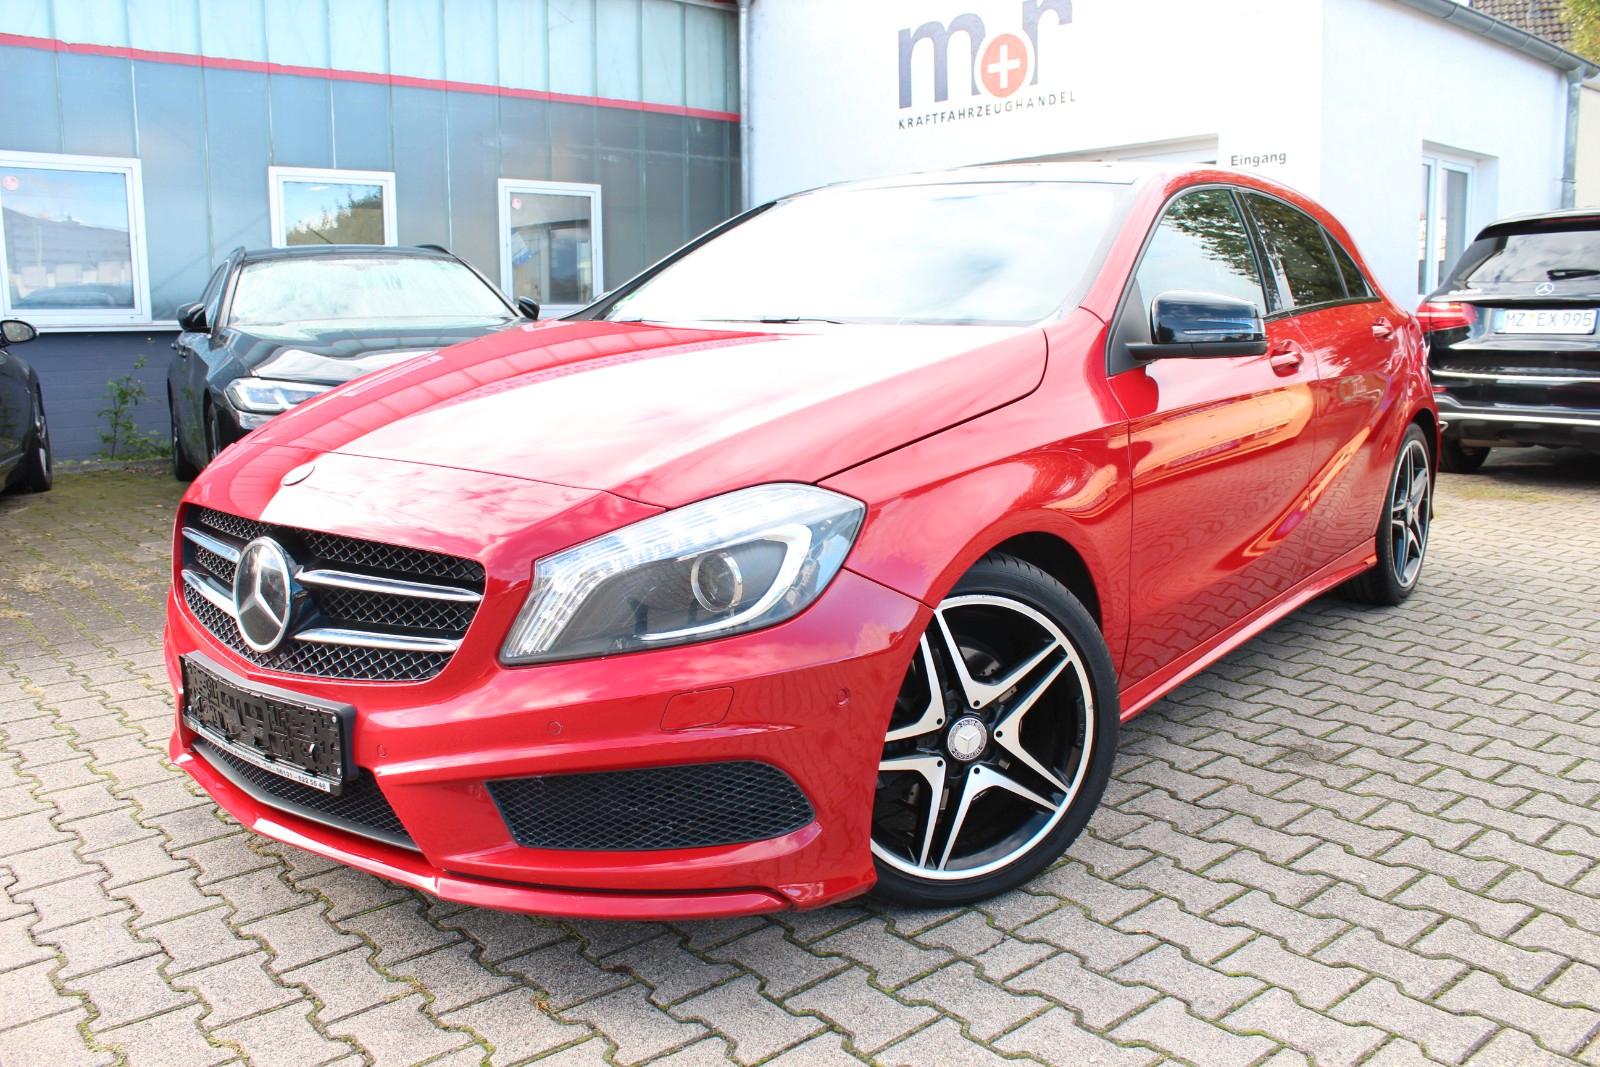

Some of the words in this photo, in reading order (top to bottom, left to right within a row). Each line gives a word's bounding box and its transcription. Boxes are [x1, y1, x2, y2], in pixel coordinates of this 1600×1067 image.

[898, 90, 1076, 130] KRAFTFAHRZEUGHANDEL
[1231, 153, 1287, 167] Eingang
[1506, 313, 1526, 327] MZ
[1536, 312, 1558, 327] EX
[1563, 312, 1593, 327] 995
